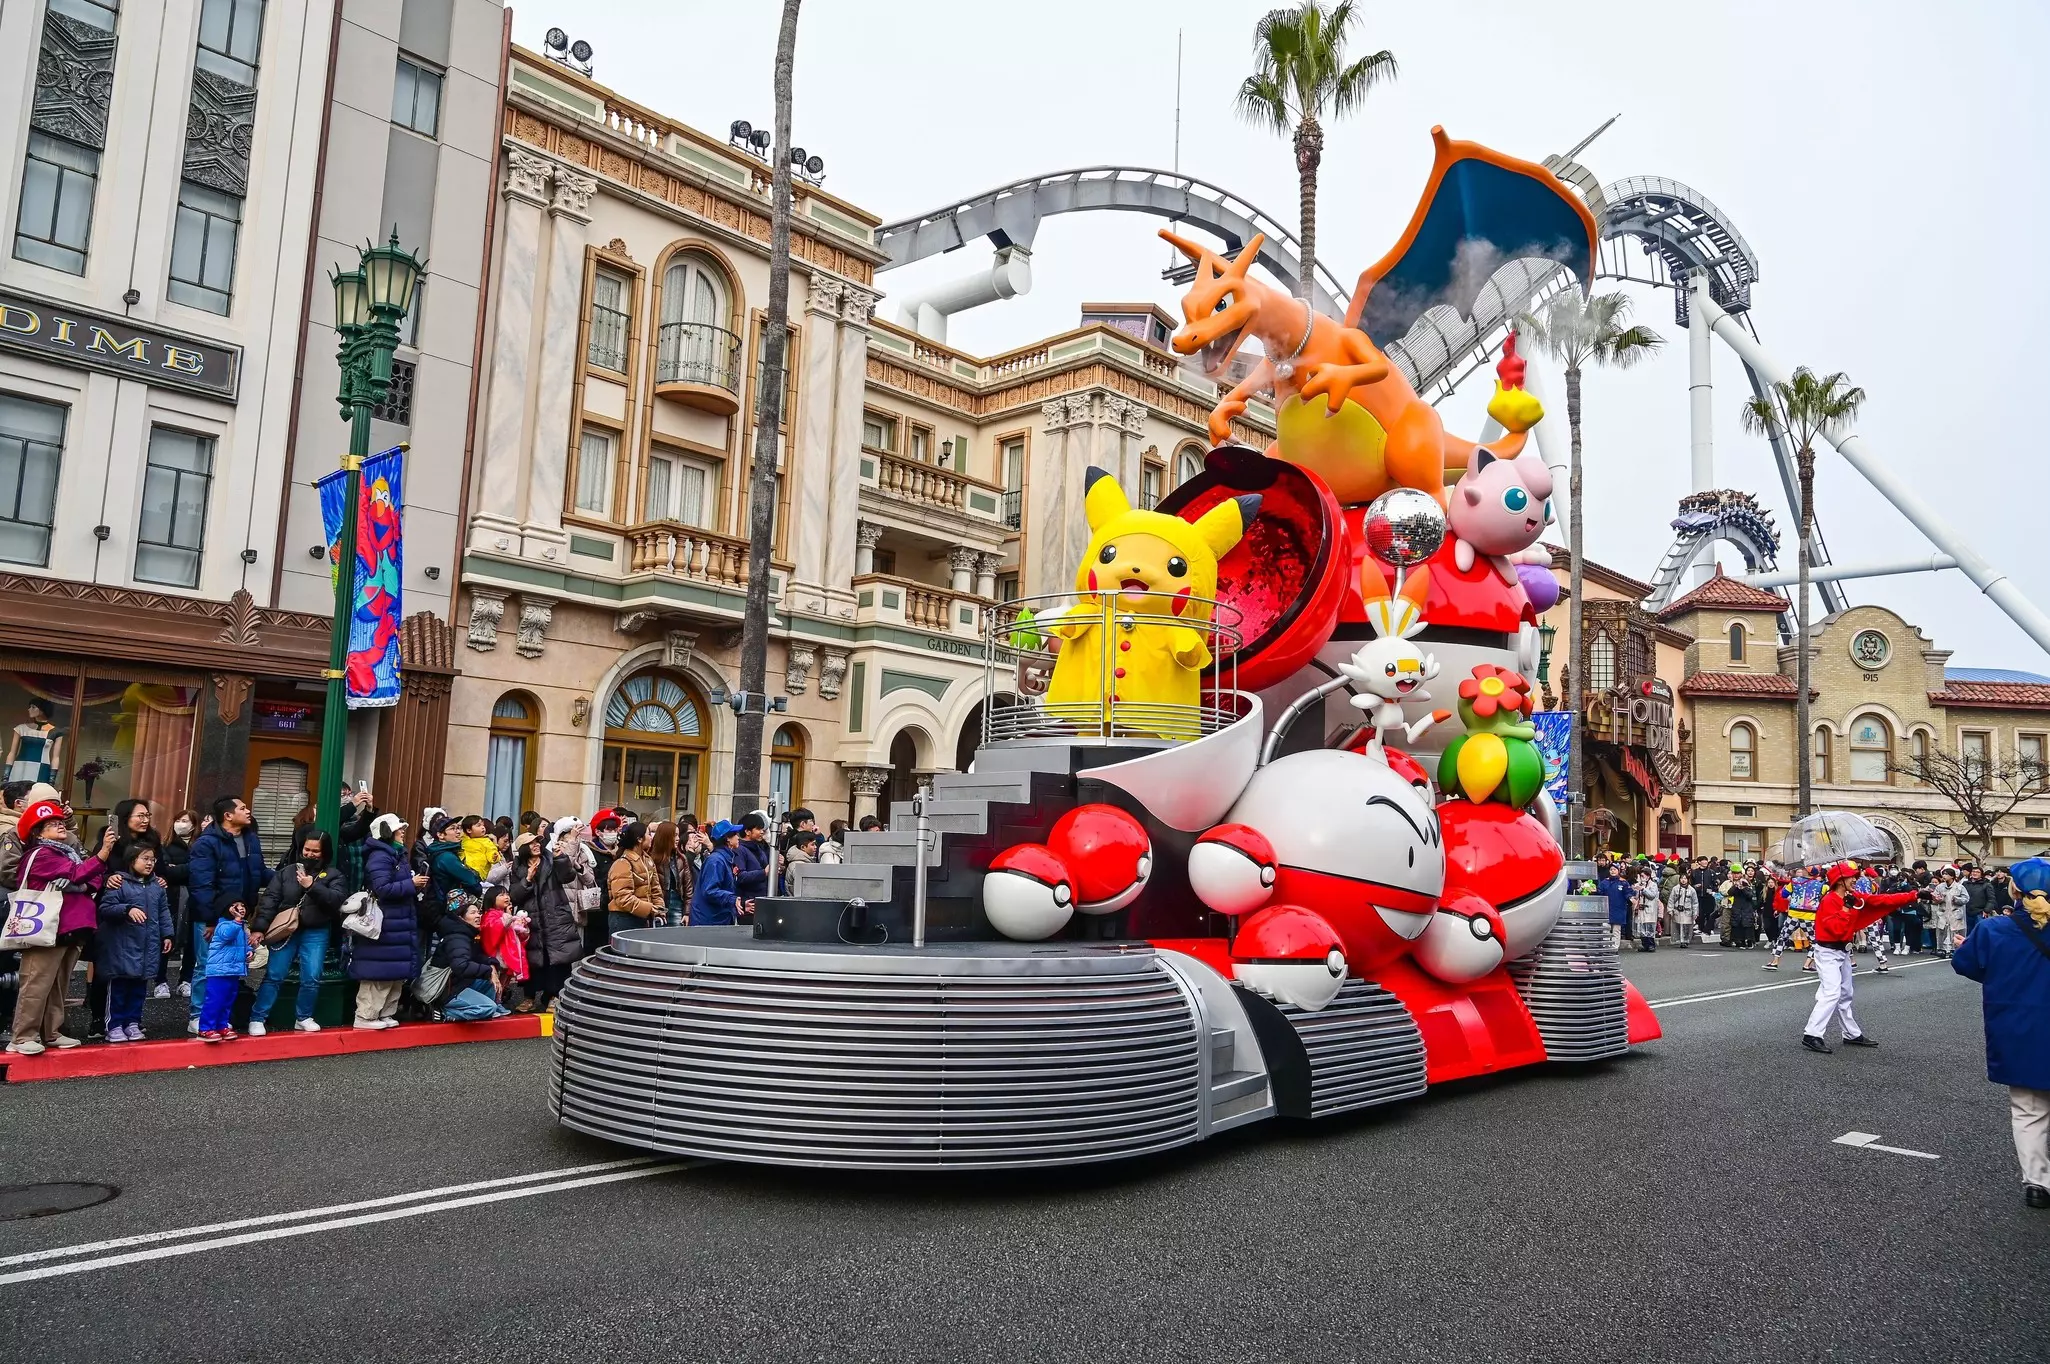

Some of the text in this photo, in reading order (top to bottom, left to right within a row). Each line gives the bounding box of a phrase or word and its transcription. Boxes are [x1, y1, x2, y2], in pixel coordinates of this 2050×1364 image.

[0, 304, 205, 377] DIME
[927, 638, 972, 657] GARDEN
[1862, 673, 1879, 682] 1915
[39, 807, 52, 817] M
[5, 900, 46, 937] B
